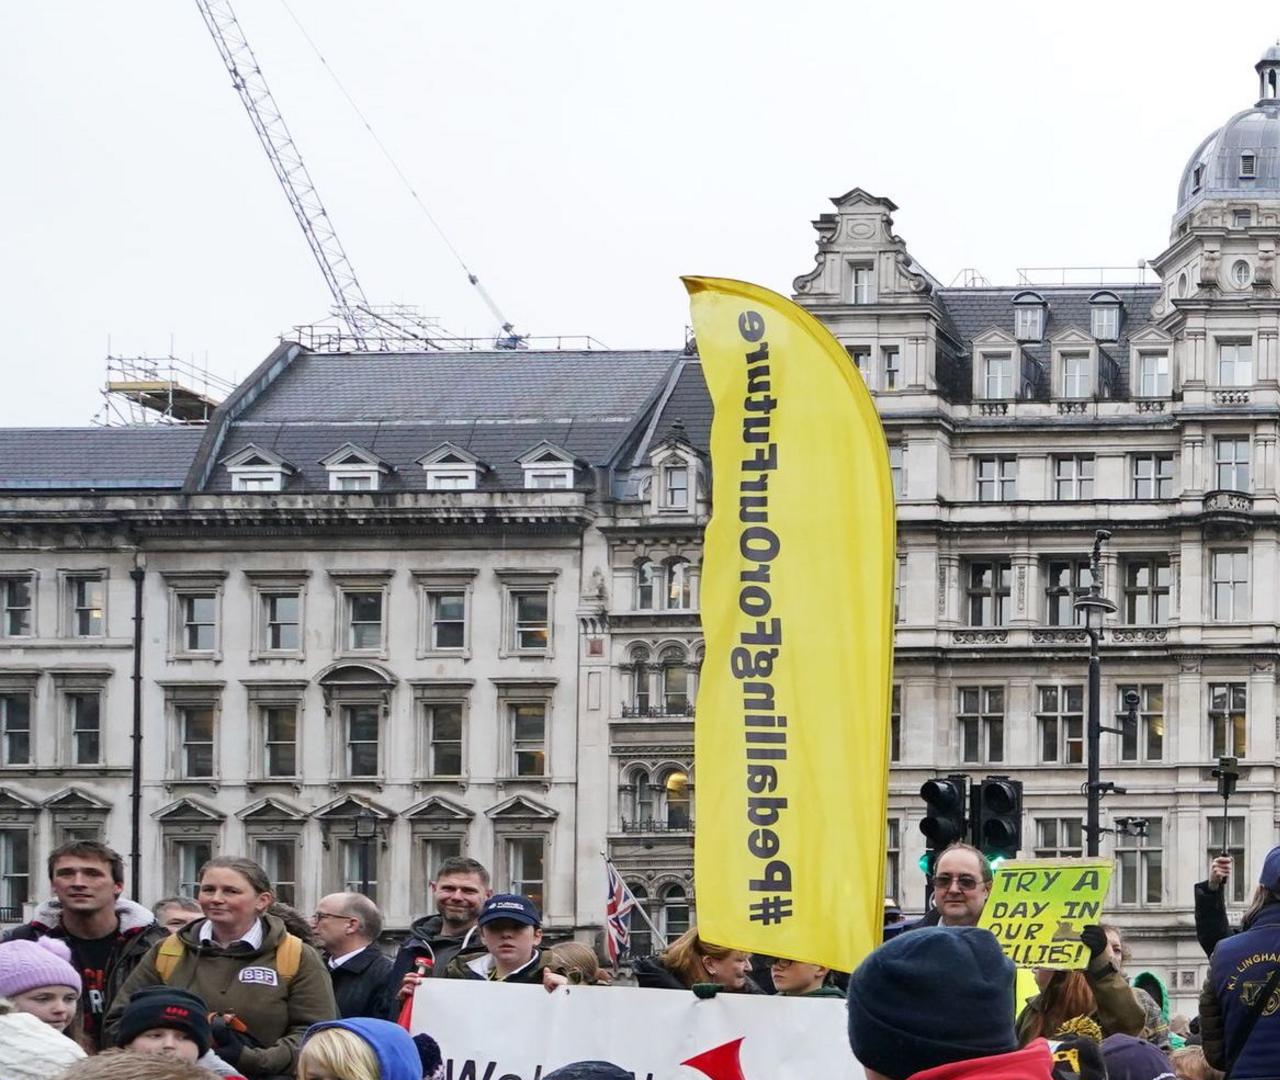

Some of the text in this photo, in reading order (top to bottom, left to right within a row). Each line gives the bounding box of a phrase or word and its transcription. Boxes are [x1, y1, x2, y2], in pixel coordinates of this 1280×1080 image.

[1001, 870, 1099, 892] TRY A
[993, 901, 1099, 919] DAY IN
[989, 923, 1044, 940] OUR
[1001, 944, 1084, 964] ELLIES!
